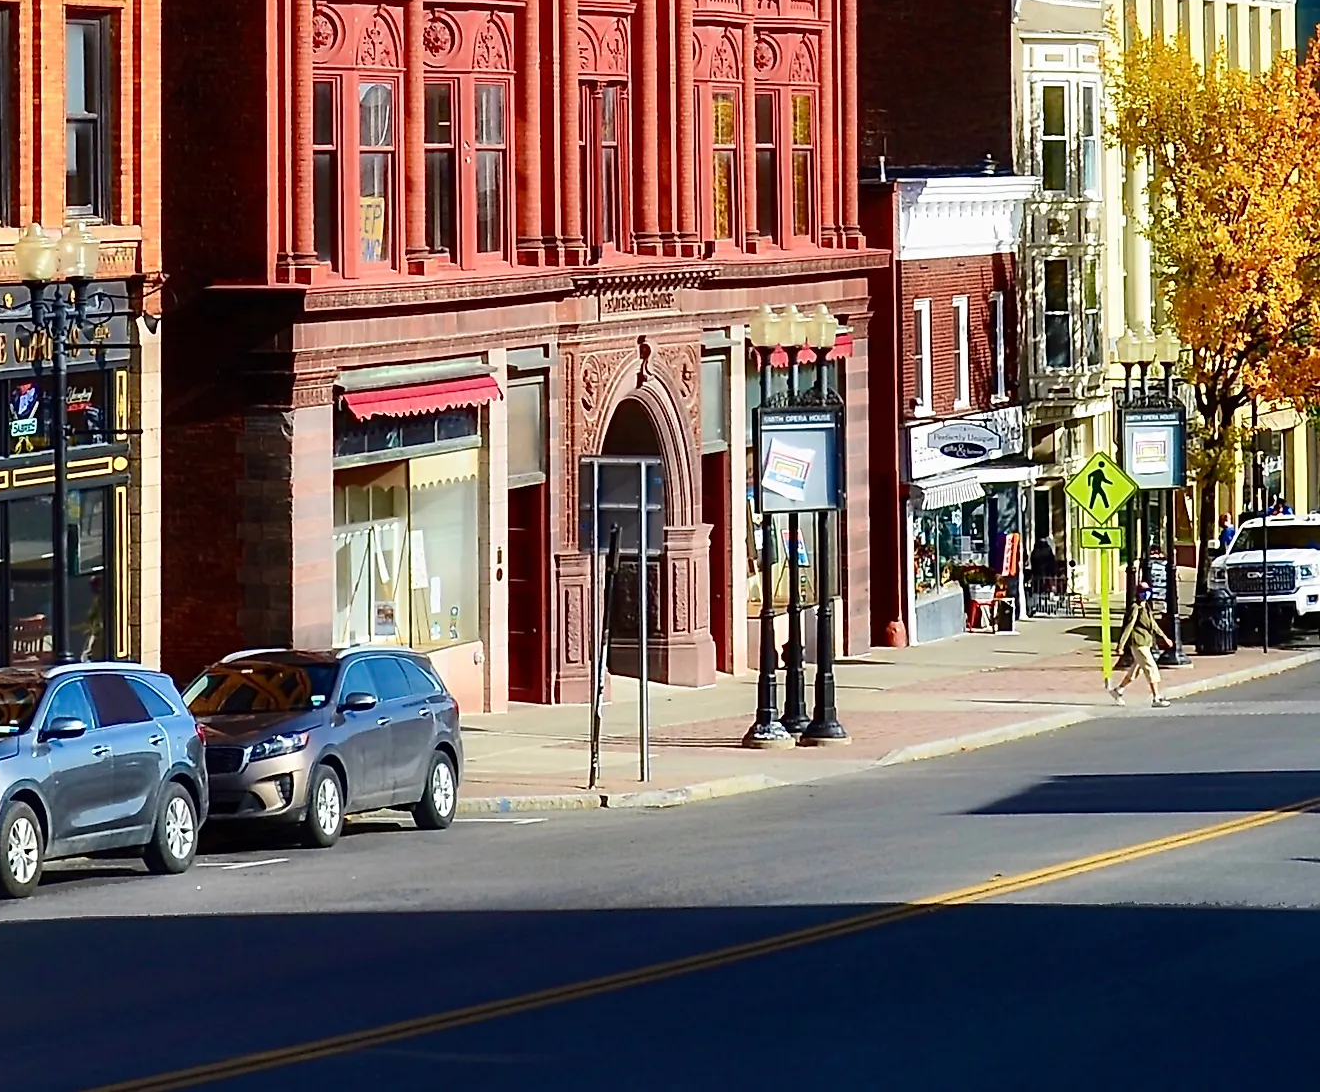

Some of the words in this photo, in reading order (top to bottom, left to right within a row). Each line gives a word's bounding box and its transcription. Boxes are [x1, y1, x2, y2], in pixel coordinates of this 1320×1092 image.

[785, 414, 808, 422] OPERA
[809, 413, 831, 422] HOUSE
[956, 443, 968, 458] &
[1247, 571, 1274, 580] GMC
